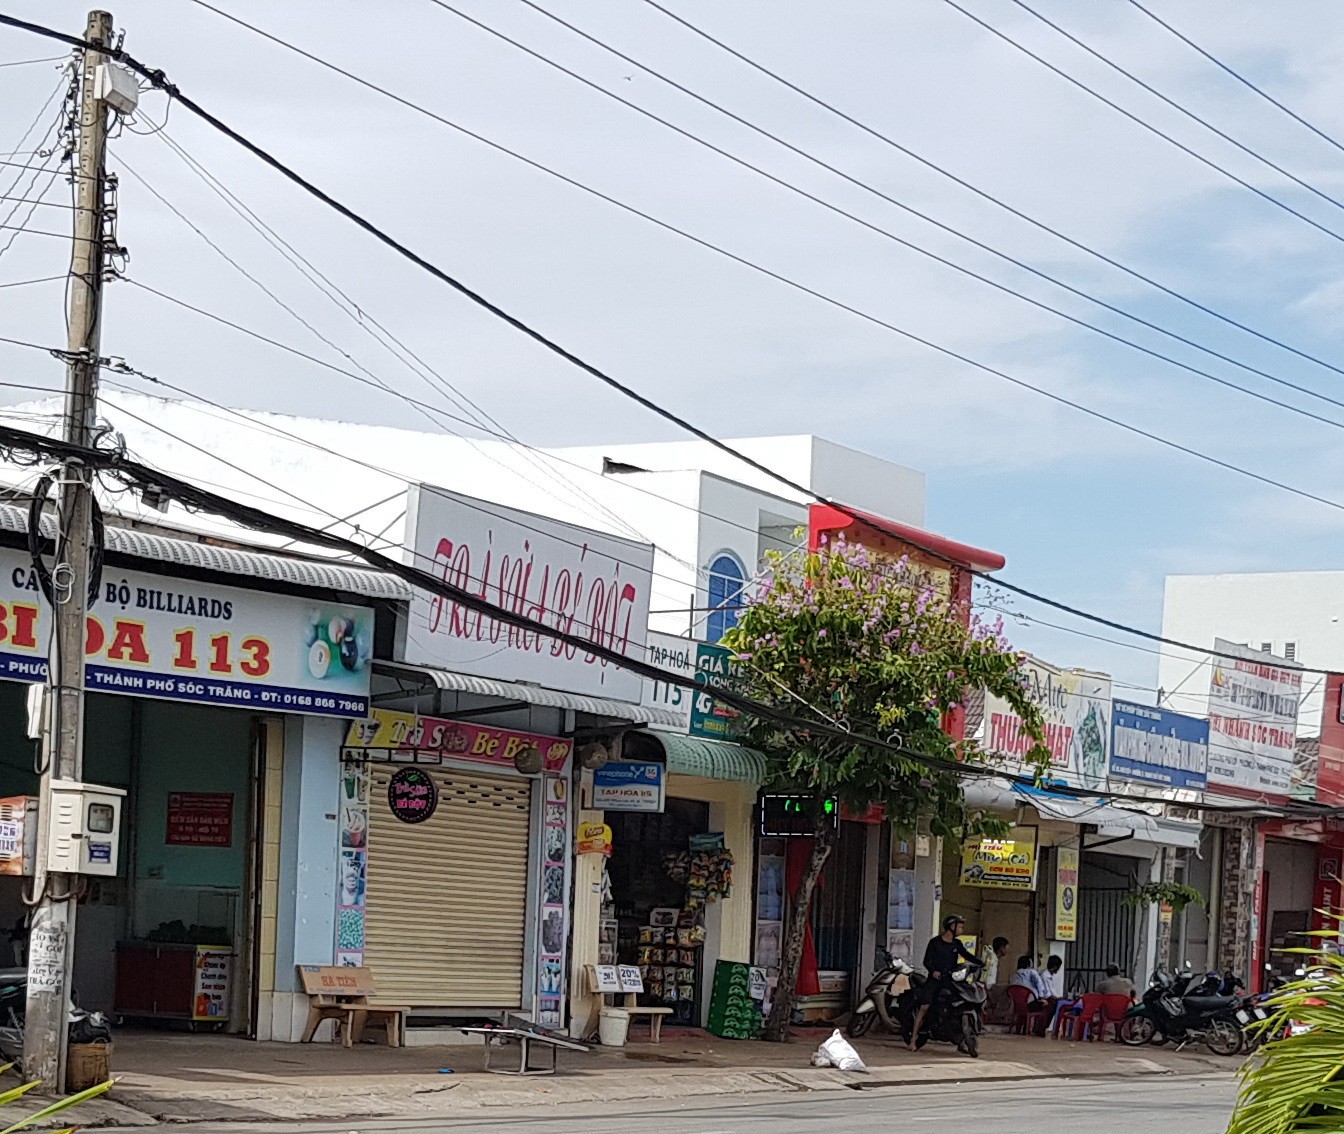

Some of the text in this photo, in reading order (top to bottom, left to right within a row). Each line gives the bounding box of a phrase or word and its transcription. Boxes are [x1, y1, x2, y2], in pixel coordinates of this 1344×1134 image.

[106, 578, 131, 611] BỘ
[136, 587, 234, 621] BILLIARDS
[173, 629, 272, 679] 113
[94, 671, 143, 689] THÀNH
[146, 676, 175, 692] PHỐ
[177, 681, 205, 696] SÓC
[207, 685, 252, 700] TRĂNG
[471, 730, 500, 757] Bé
